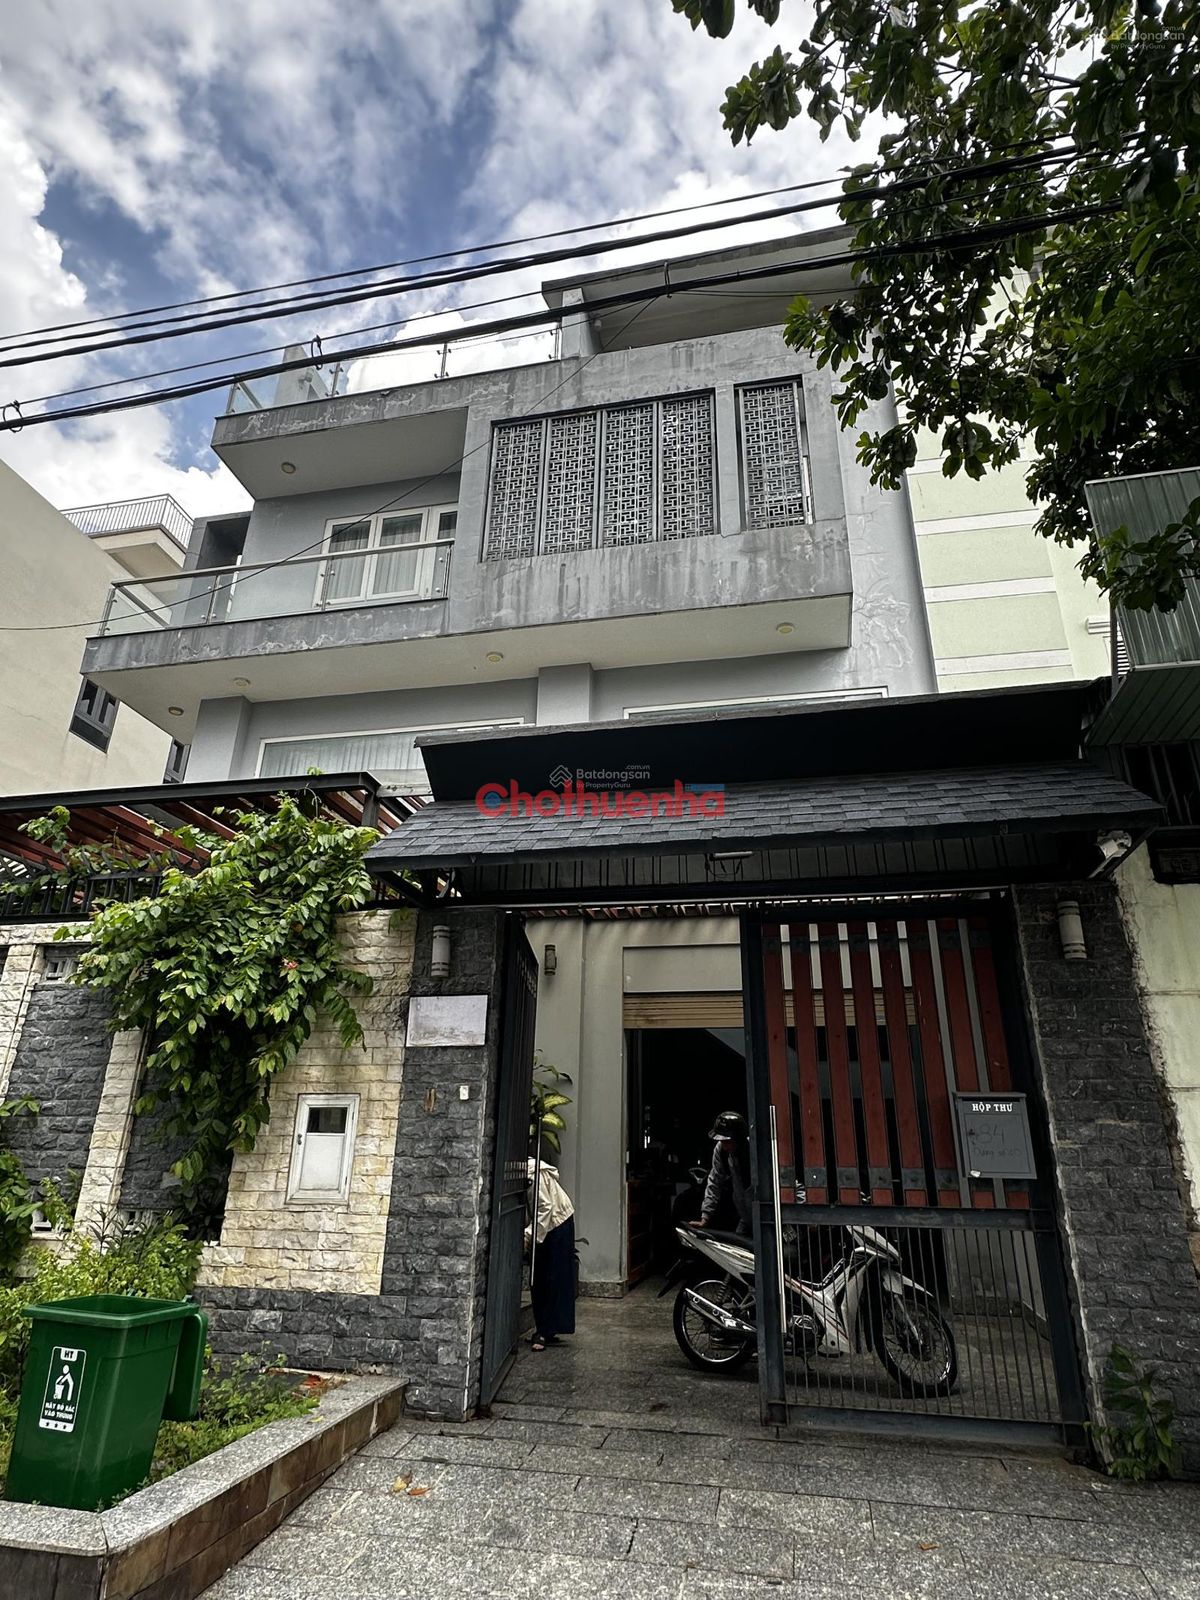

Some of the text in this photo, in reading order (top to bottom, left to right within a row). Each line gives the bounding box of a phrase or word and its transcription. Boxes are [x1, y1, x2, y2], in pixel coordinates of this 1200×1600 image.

[972, 1102, 1013, 1112] HỘP THƯ
[64, 1350, 74, 1359] HT
